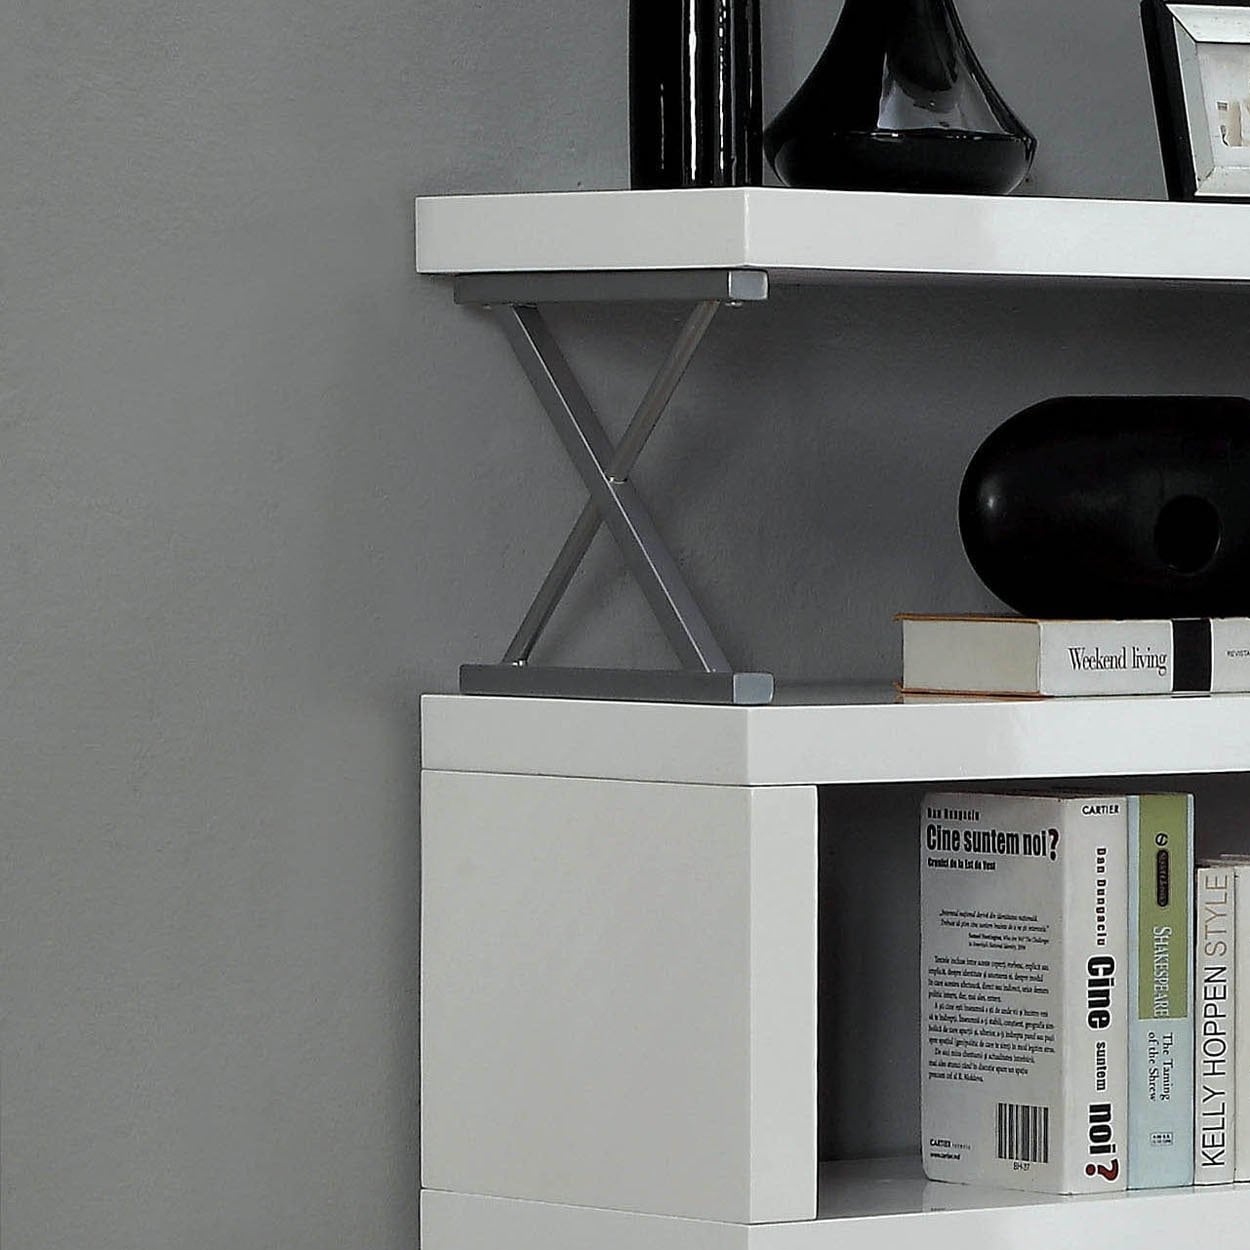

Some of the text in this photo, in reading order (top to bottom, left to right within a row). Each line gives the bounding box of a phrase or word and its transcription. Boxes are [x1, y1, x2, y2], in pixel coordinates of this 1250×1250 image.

[1068, 646, 1168, 677] Weekend living
[926, 824, 1060, 862] Cine suntem noi?
[1081, 805, 1120, 815] CARTIER
[1096, 847, 1107, 874] Dan
[1087, 955, 1115, 1030] Cine
[1153, 926, 1172, 1017] SHAKESPEARE
[1201, 875, 1228, 1167] KELLY HOPPEN STYLE
[1148, 1031, 1160, 1100] of the Shrew
[1159, 1031, 1174, 1101] The Taming
[1085, 1103, 1120, 1181] noi?
